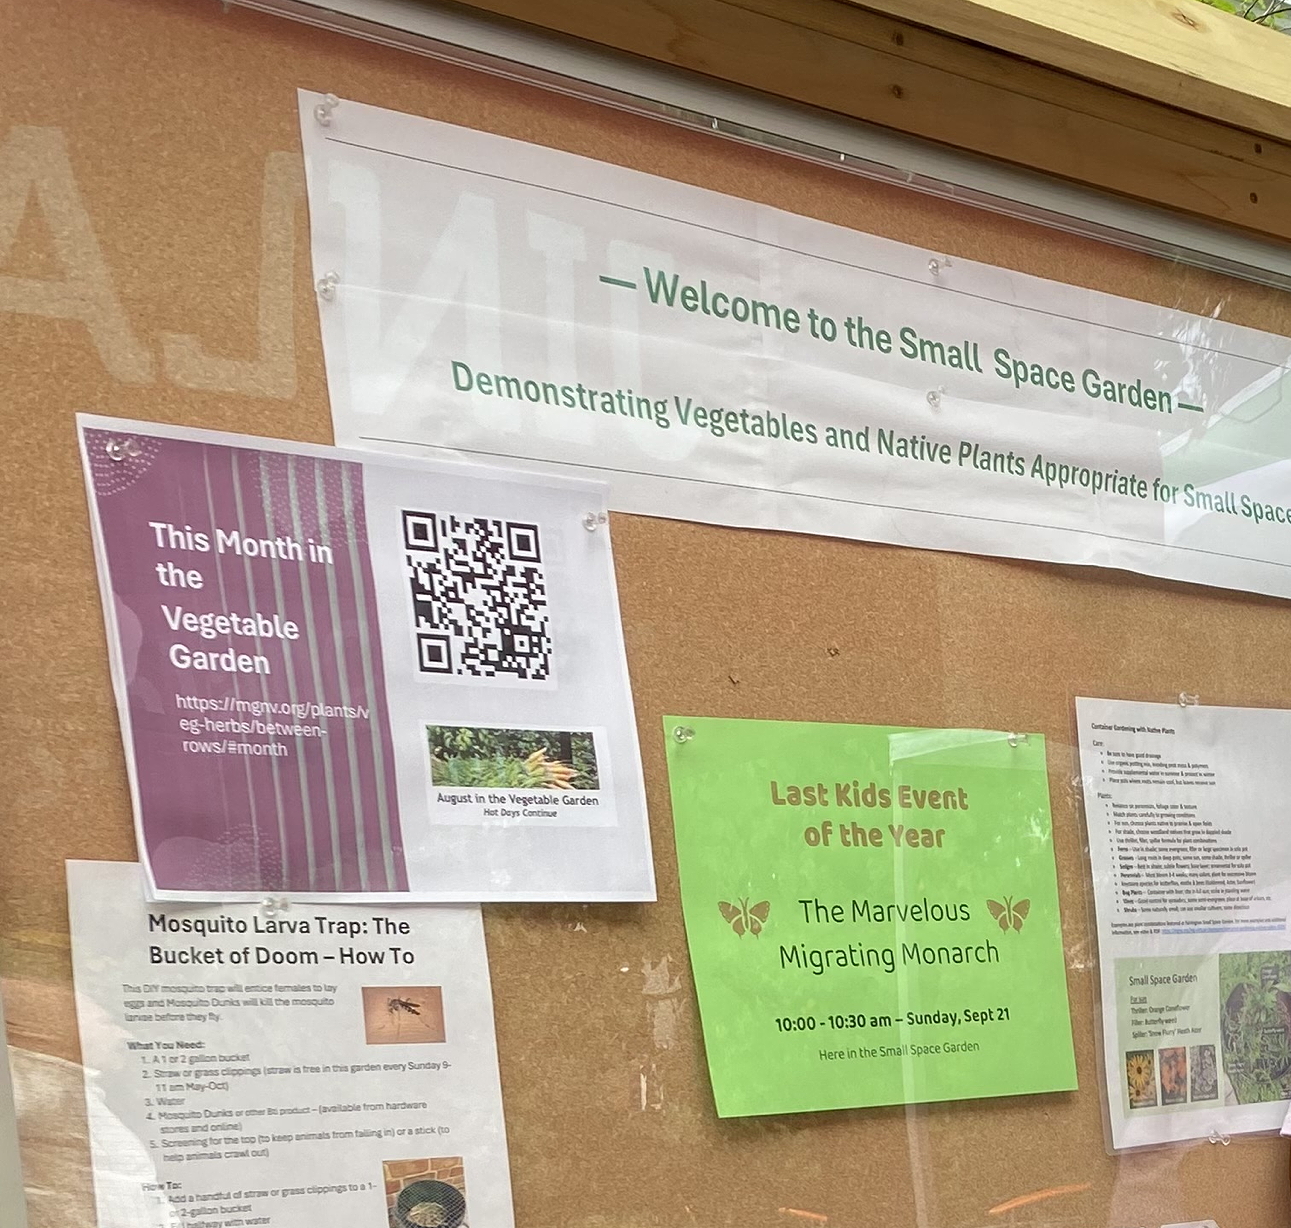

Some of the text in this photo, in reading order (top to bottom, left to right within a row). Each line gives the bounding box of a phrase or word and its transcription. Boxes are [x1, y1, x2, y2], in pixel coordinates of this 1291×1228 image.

[643, 267, 1172, 413] Welcome to the Small Space Garden
[451, 361, 670, 429] Demonstrating
[674, 396, 818, 444] Vegetables
[826, 426, 870, 452] and
[878, 429, 951, 464] Native
[959, 441, 1025, 476] Plants
[1031, 454, 1147, 498] Appropriate
[1153, 478, 1179, 504] for
[1184, 484, 1238, 515] Small
[149, 522, 333, 564] This Month in
[155, 562, 204, 589] the
[161, 605, 300, 640] Vegetable
[169, 644, 271, 674] Garden
[176, 694, 369, 719] https://mgnv.org/plants/v
[180, 717, 327, 737] eg-herbs/between-
[437, 793, 599, 806] August in the Vegetable Garden
[771, 780, 968, 810] Last Kids Event
[501, 808, 520, 818] Days
[522, 809, 557, 817] Continue
[804, 821, 945, 848] of the Year
[798, 898, 970, 923] The Marvelous
[148, 914, 410, 938] Mosquito Larva Trap: The
[150, 946, 414, 964] Bucket of Doom How To
[780, 939, 999, 975] Migrating Monarch
[1129, 973, 1197, 986] Small Space Garden
[775, 1008, 1009, 1032] 10:00 10:30 am Sunday, Sept 21
[819, 1041, 979, 1060] Here in the Small Space Garden
